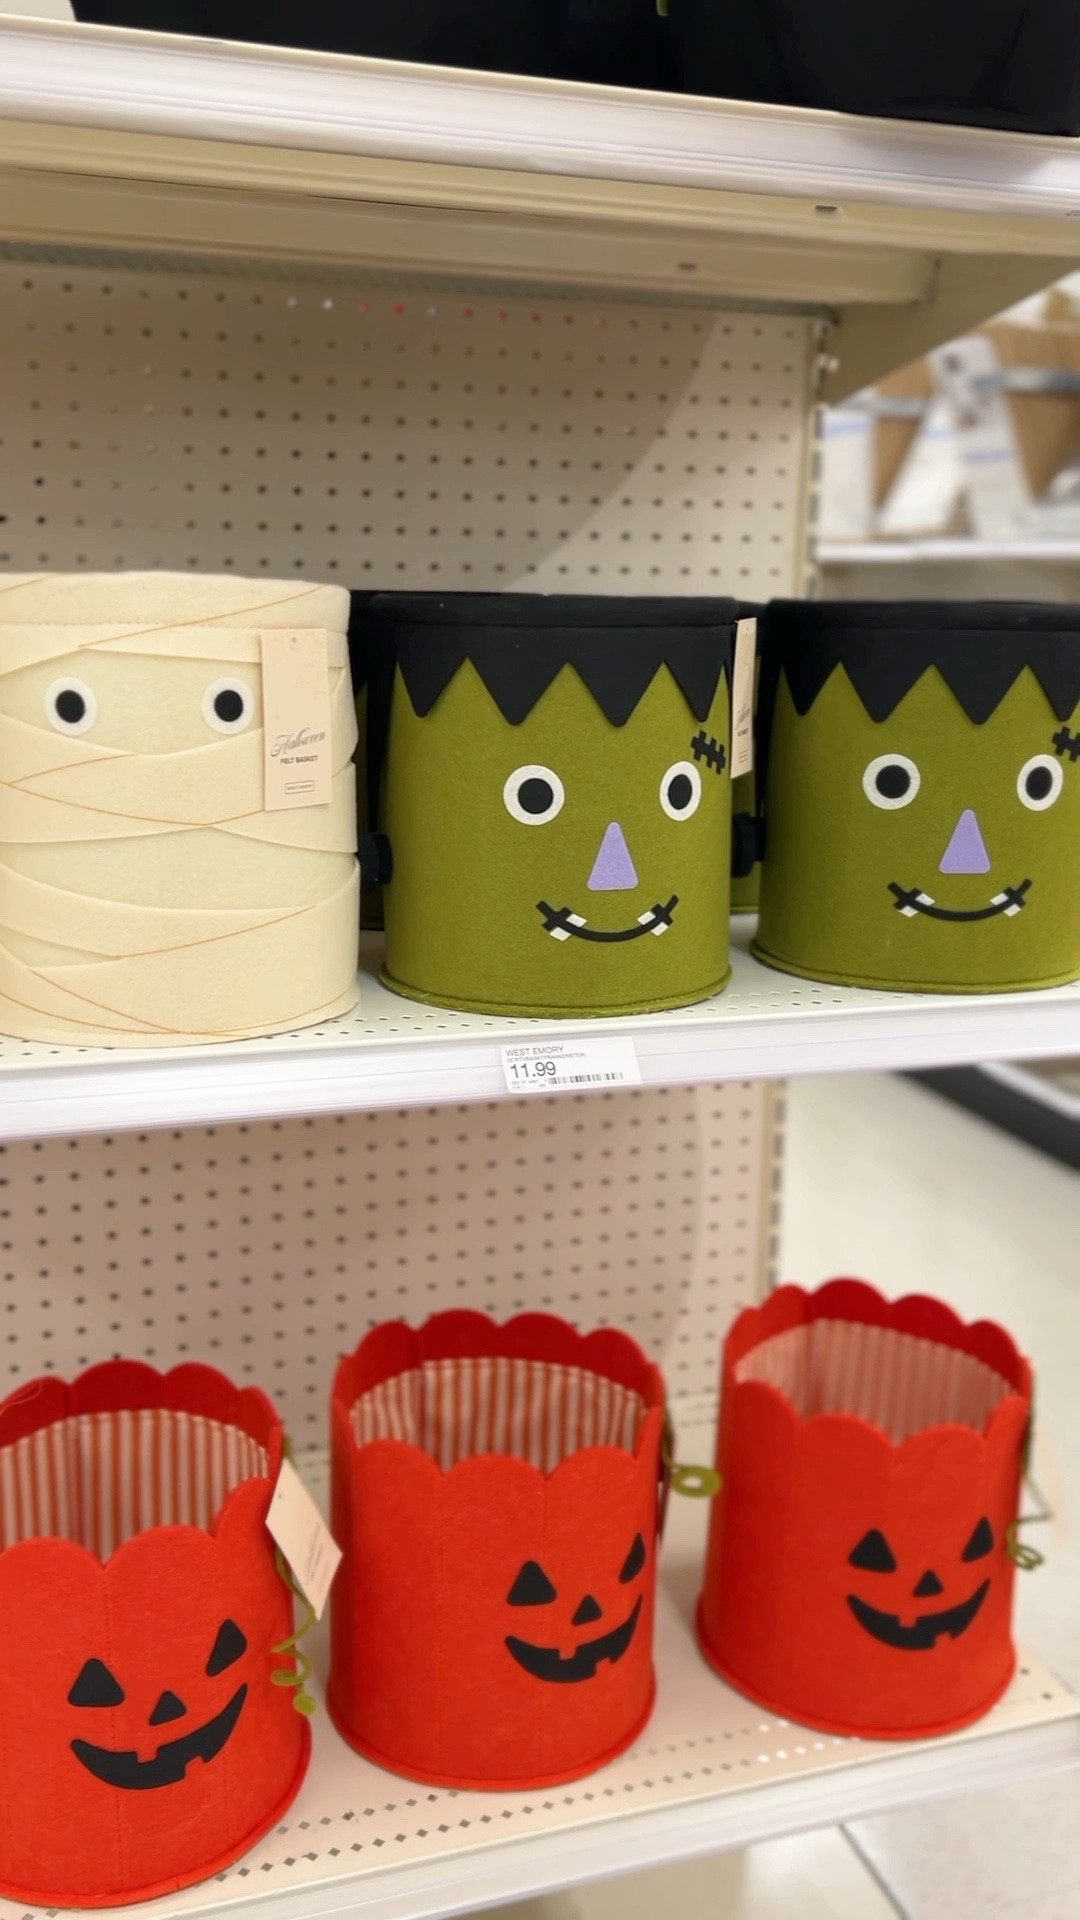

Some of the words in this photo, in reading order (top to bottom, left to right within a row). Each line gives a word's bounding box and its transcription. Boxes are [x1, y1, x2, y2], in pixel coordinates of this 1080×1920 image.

[295, 755, 318, 763] BASKET
[505, 1048, 530, 1056] WEST
[532, 1046, 564, 1055] EMORY
[510, 1061, 556, 1078] 11.99
